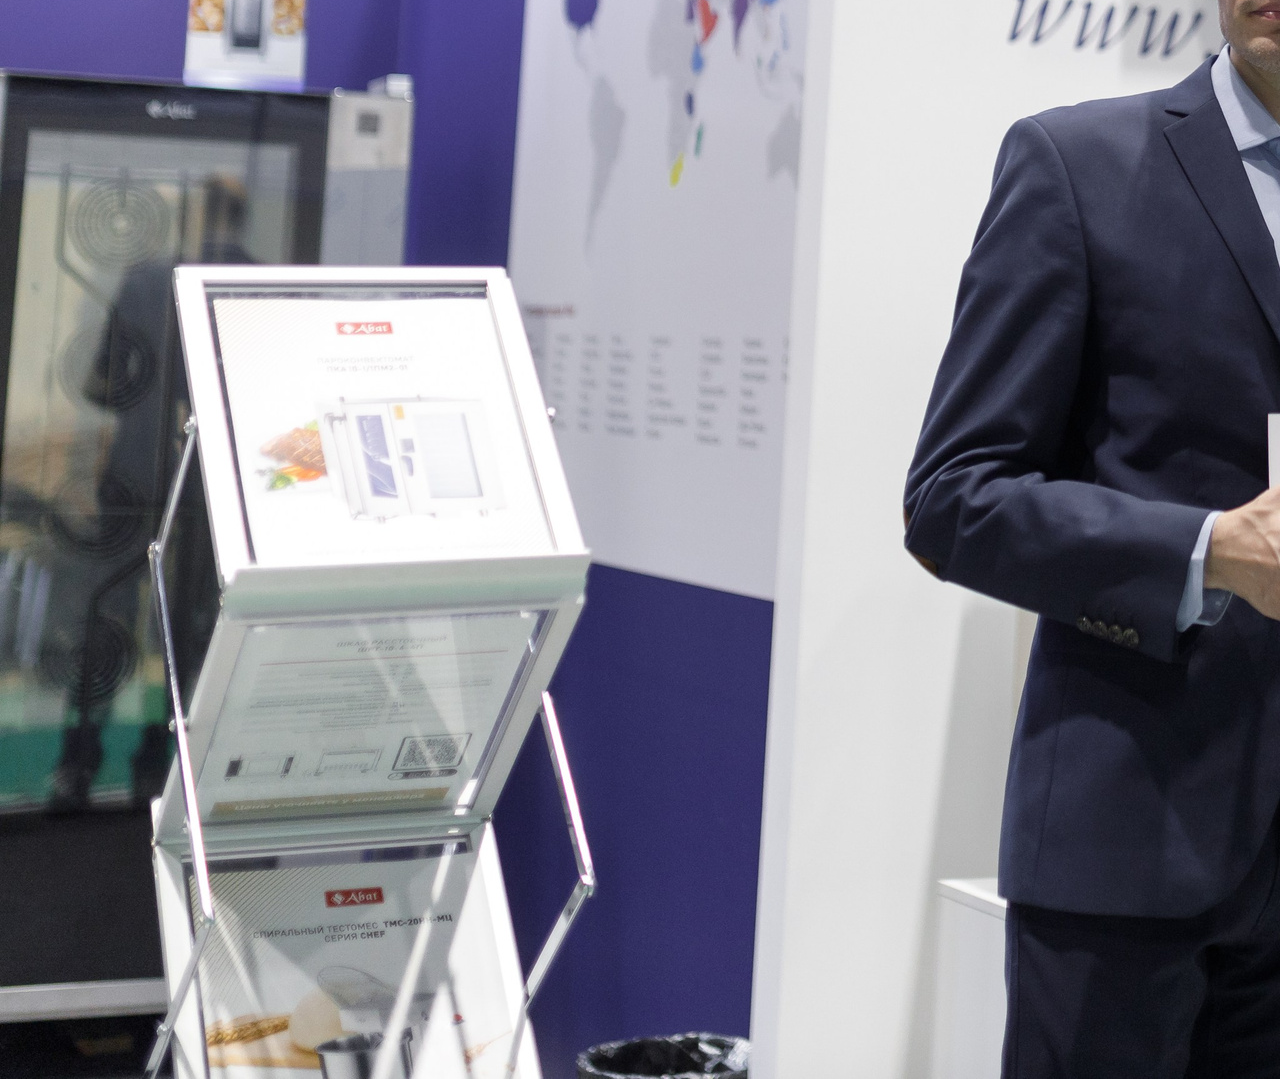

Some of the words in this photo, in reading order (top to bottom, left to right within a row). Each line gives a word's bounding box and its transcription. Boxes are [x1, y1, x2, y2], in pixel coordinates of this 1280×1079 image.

[354, 323, 388, 334] Abat
[346, 890, 380, 904] Abat
[253, 925, 324, 939] СПИРАЛЬНЫЙ
[327, 921, 379, 934] ТЕСТОМЕС
[383, 914, 453, 929] ТМС-20-МЦ
[324, 932, 358, 943] СЕРИЯ
[360, 930, 386, 940] CHEF
